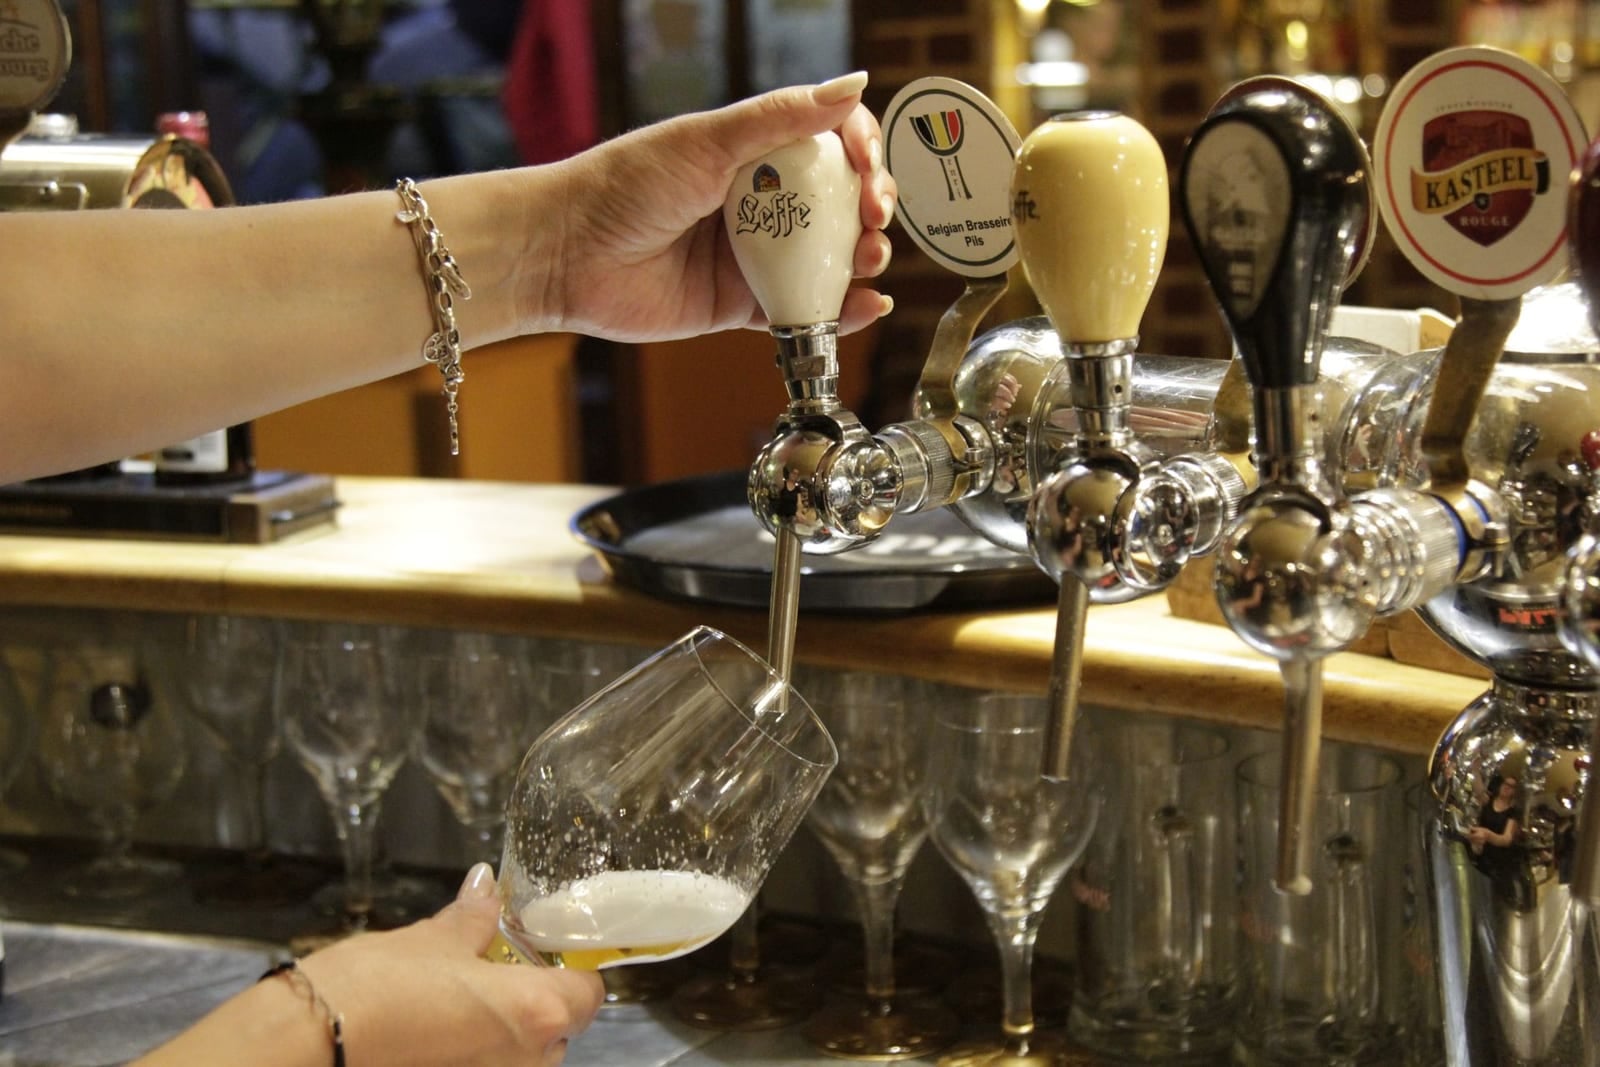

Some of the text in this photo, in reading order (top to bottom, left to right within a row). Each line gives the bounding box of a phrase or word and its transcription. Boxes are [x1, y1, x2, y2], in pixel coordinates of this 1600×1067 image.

[1425, 156, 1533, 209] KASTEEL
[736, 191, 811, 239] Leffe
[1460, 216, 1510, 227] ROUGE
[926, 223, 965, 237] Belgian
[964, 235, 985, 248] Pils
